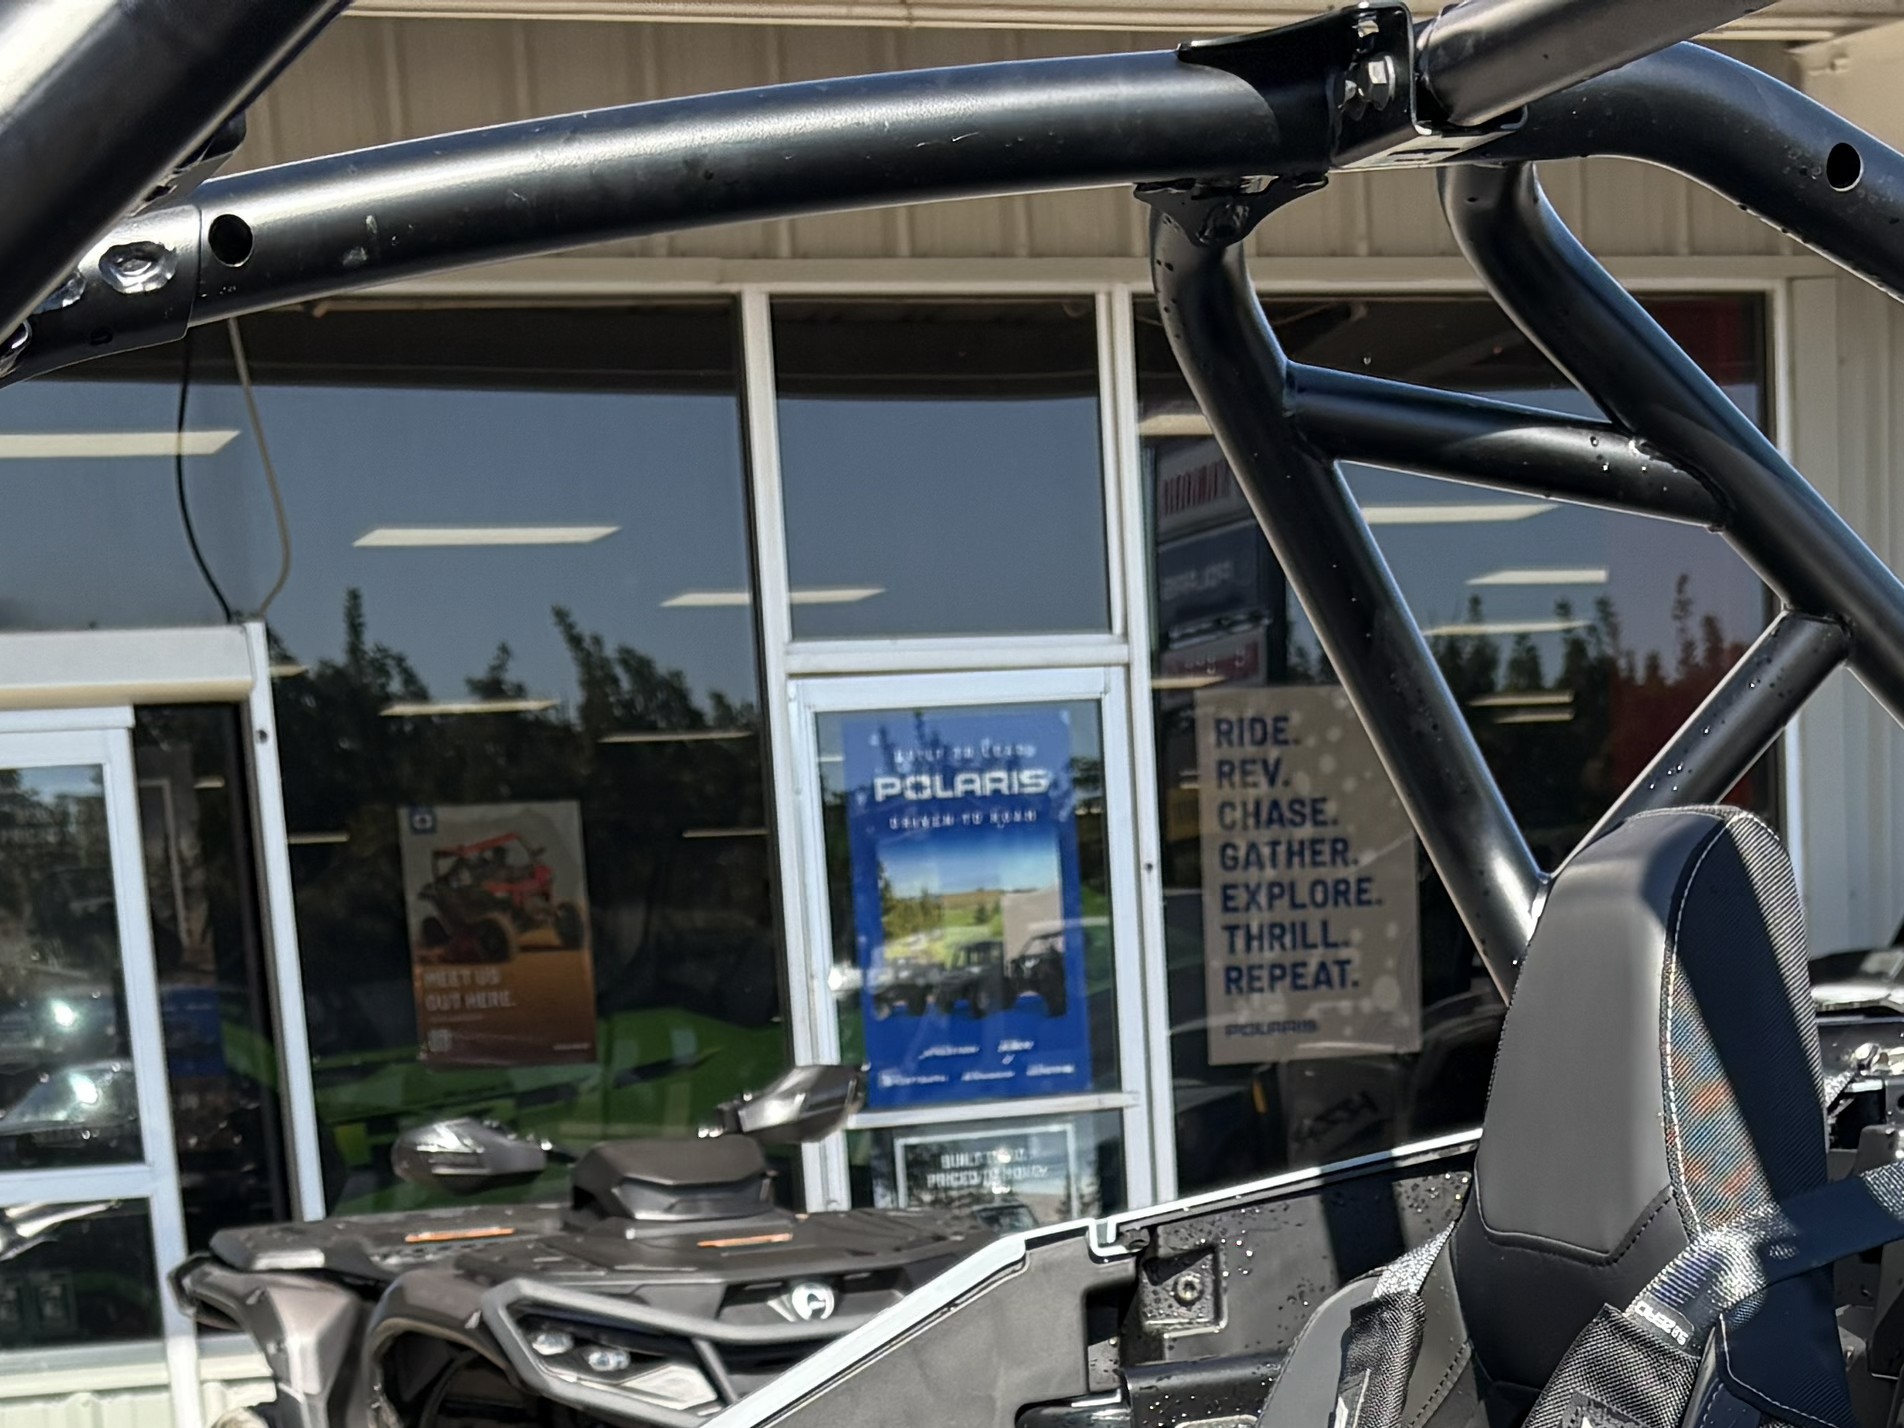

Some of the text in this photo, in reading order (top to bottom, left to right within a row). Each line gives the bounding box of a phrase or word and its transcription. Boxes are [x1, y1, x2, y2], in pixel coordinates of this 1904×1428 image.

[1214, 715, 1300, 748] RIDE.
[873, 768, 1051, 802] POLARIS
[1215, 757, 1292, 790] REV.
[1217, 797, 1339, 832] CHASE.
[1219, 838, 1359, 871] GATHER.
[1221, 877, 1383, 913] EXPLORE.
[1221, 920, 1350, 956] THRILL.
[1224, 959, 1360, 995] REPEAT.
[424, 992, 462, 1012] OUT
